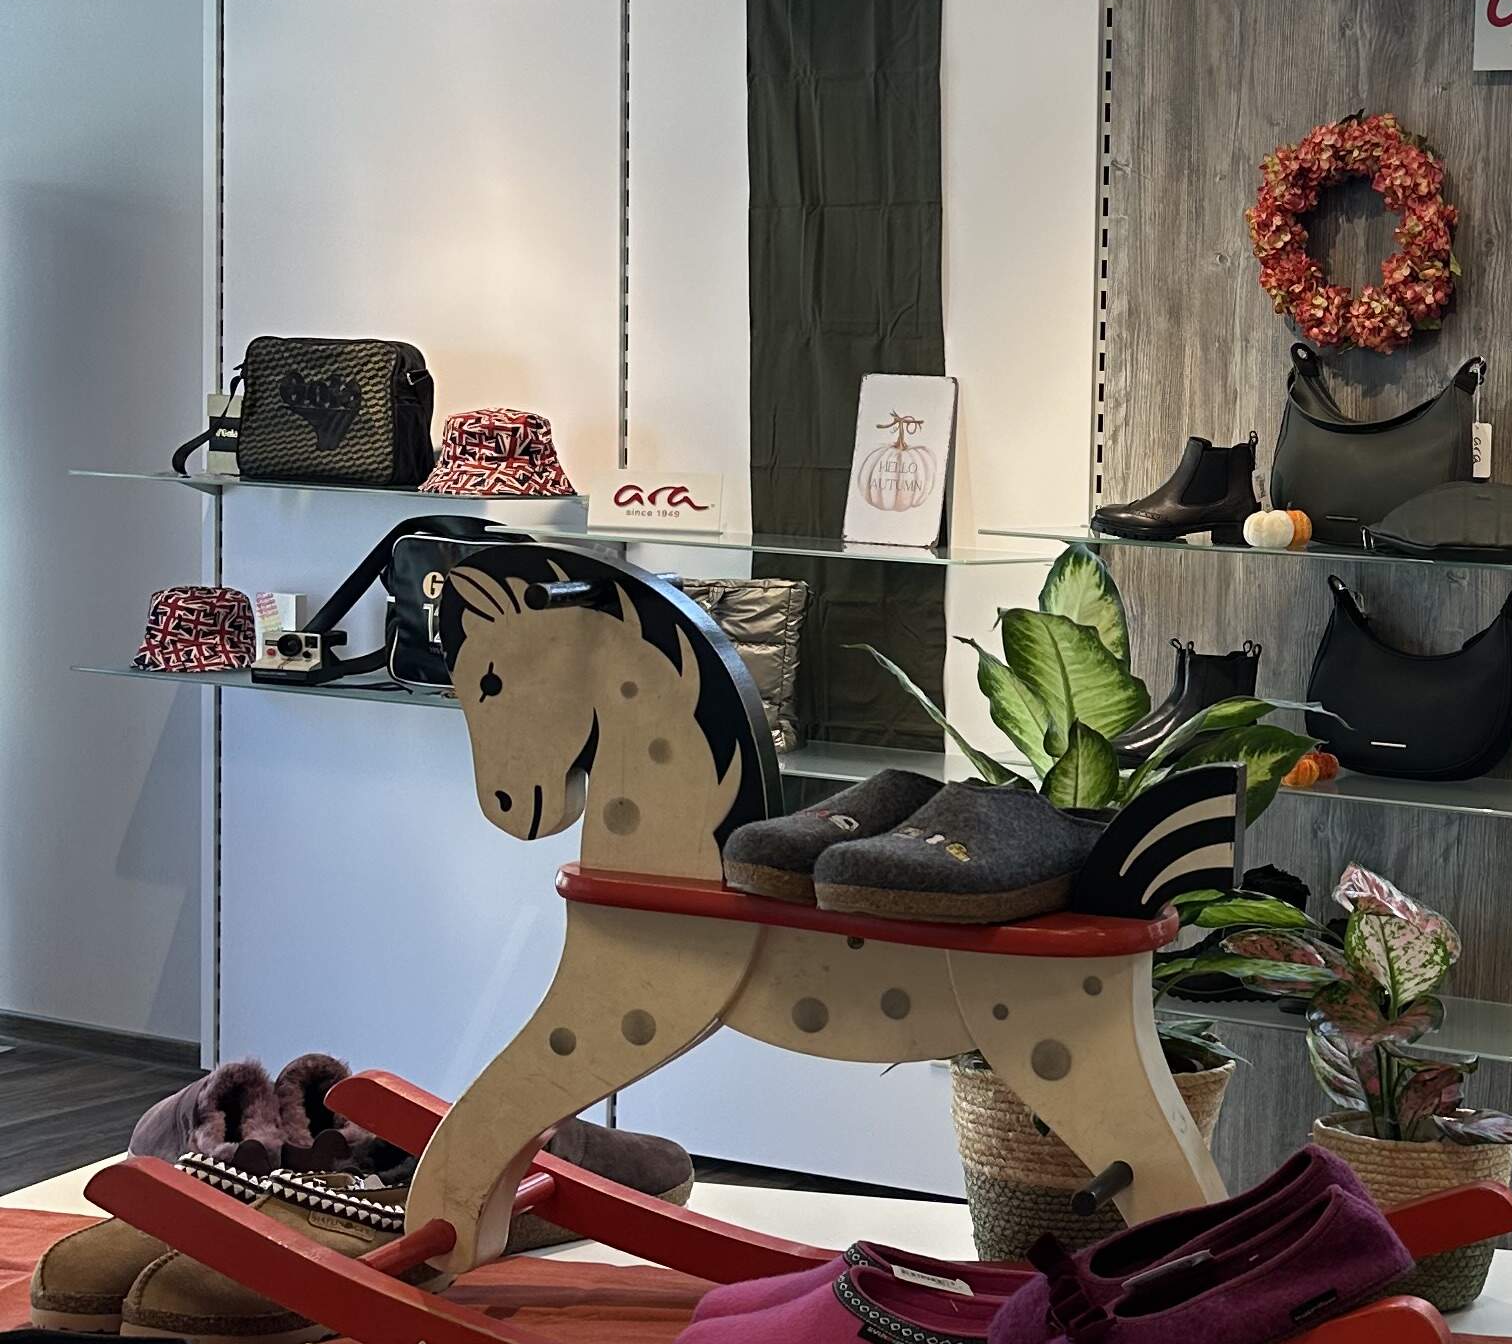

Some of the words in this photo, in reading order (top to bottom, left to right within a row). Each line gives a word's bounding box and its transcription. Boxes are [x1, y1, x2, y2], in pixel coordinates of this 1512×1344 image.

[878, 460, 918, 474] HELLO
[870, 477, 923, 492] AUTUMN
[613, 484, 709, 512] ara
[625, 508, 653, 517] since
[656, 509, 681, 518] 1949
